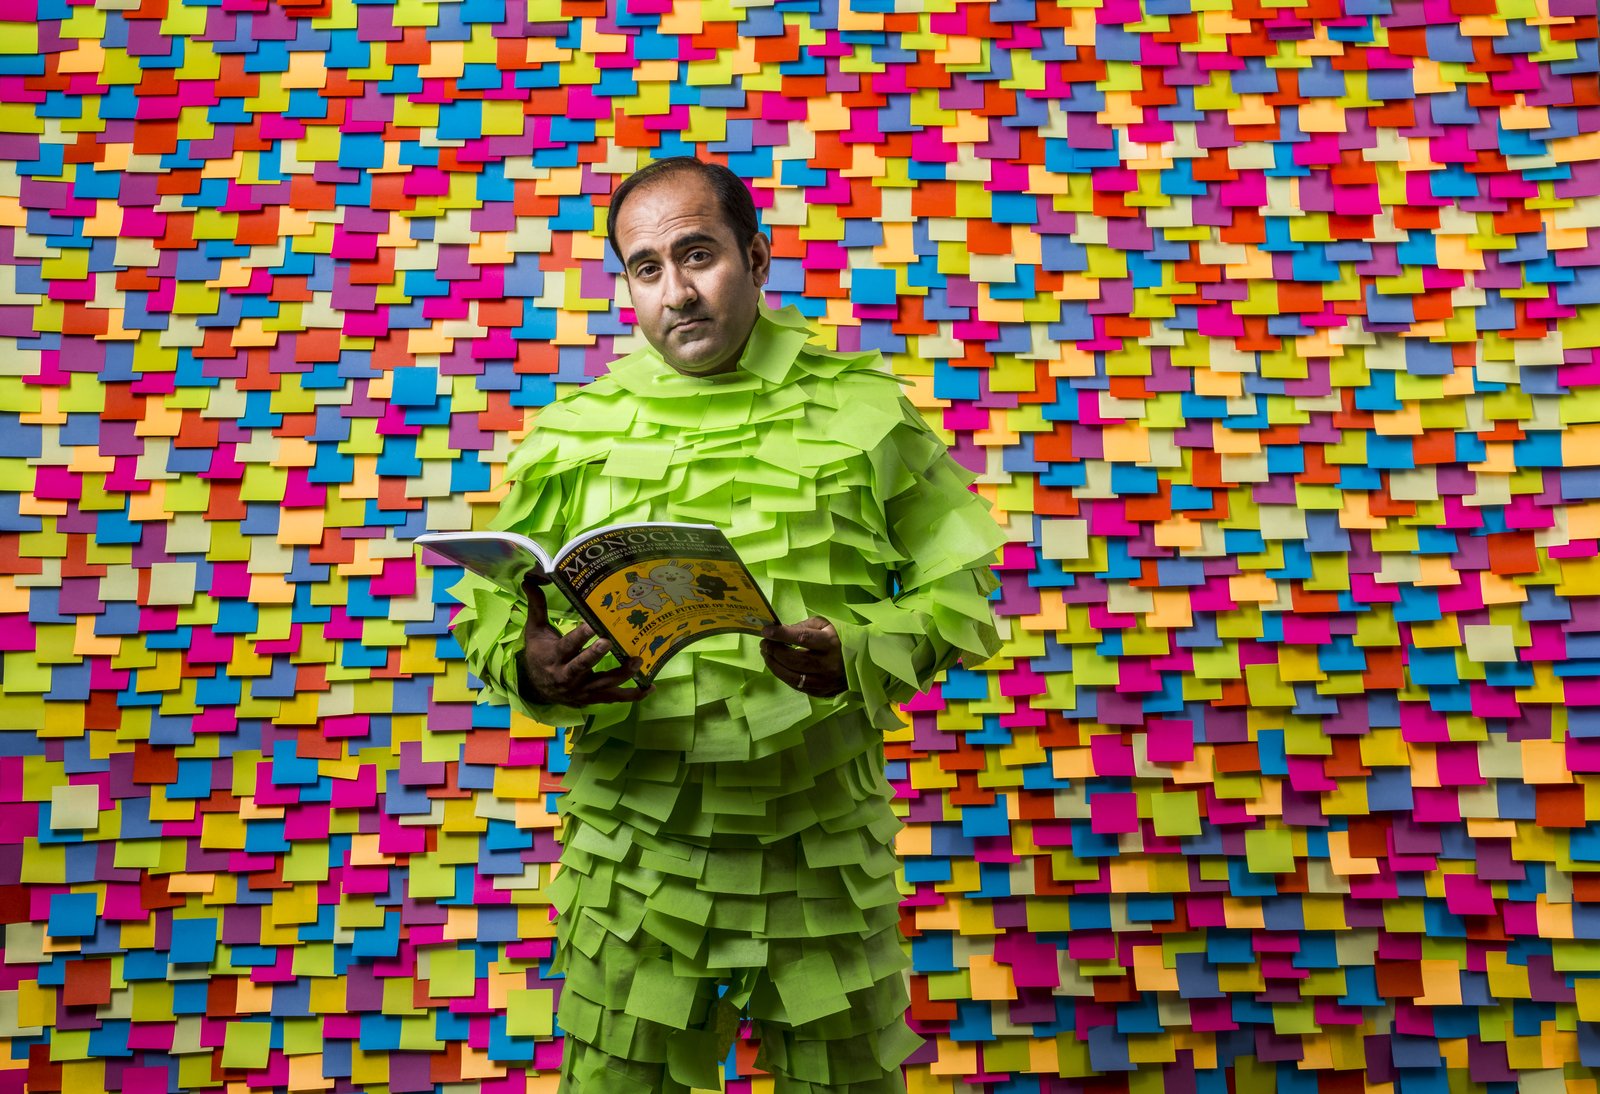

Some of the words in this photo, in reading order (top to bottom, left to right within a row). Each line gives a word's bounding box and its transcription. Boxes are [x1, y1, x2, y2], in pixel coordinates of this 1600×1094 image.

[558, 552, 576, 571] MEDIA
[562, 531, 705, 581] MONOCLE
[571, 567, 590, 587] INSIDE:
[589, 546, 628, 568] TERRORISTS
[575, 578, 586, 591] ARE
[584, 568, 596, 580] BIG
[594, 553, 624, 571] WINNERS
[624, 549, 638, 557] AND
[631, 636, 640, 646] IS
[638, 620, 657, 637] THIS
[656, 611, 675, 622] THE
[675, 603, 711, 614] FUTURE
[726, 603, 759, 612] MEDIA?
